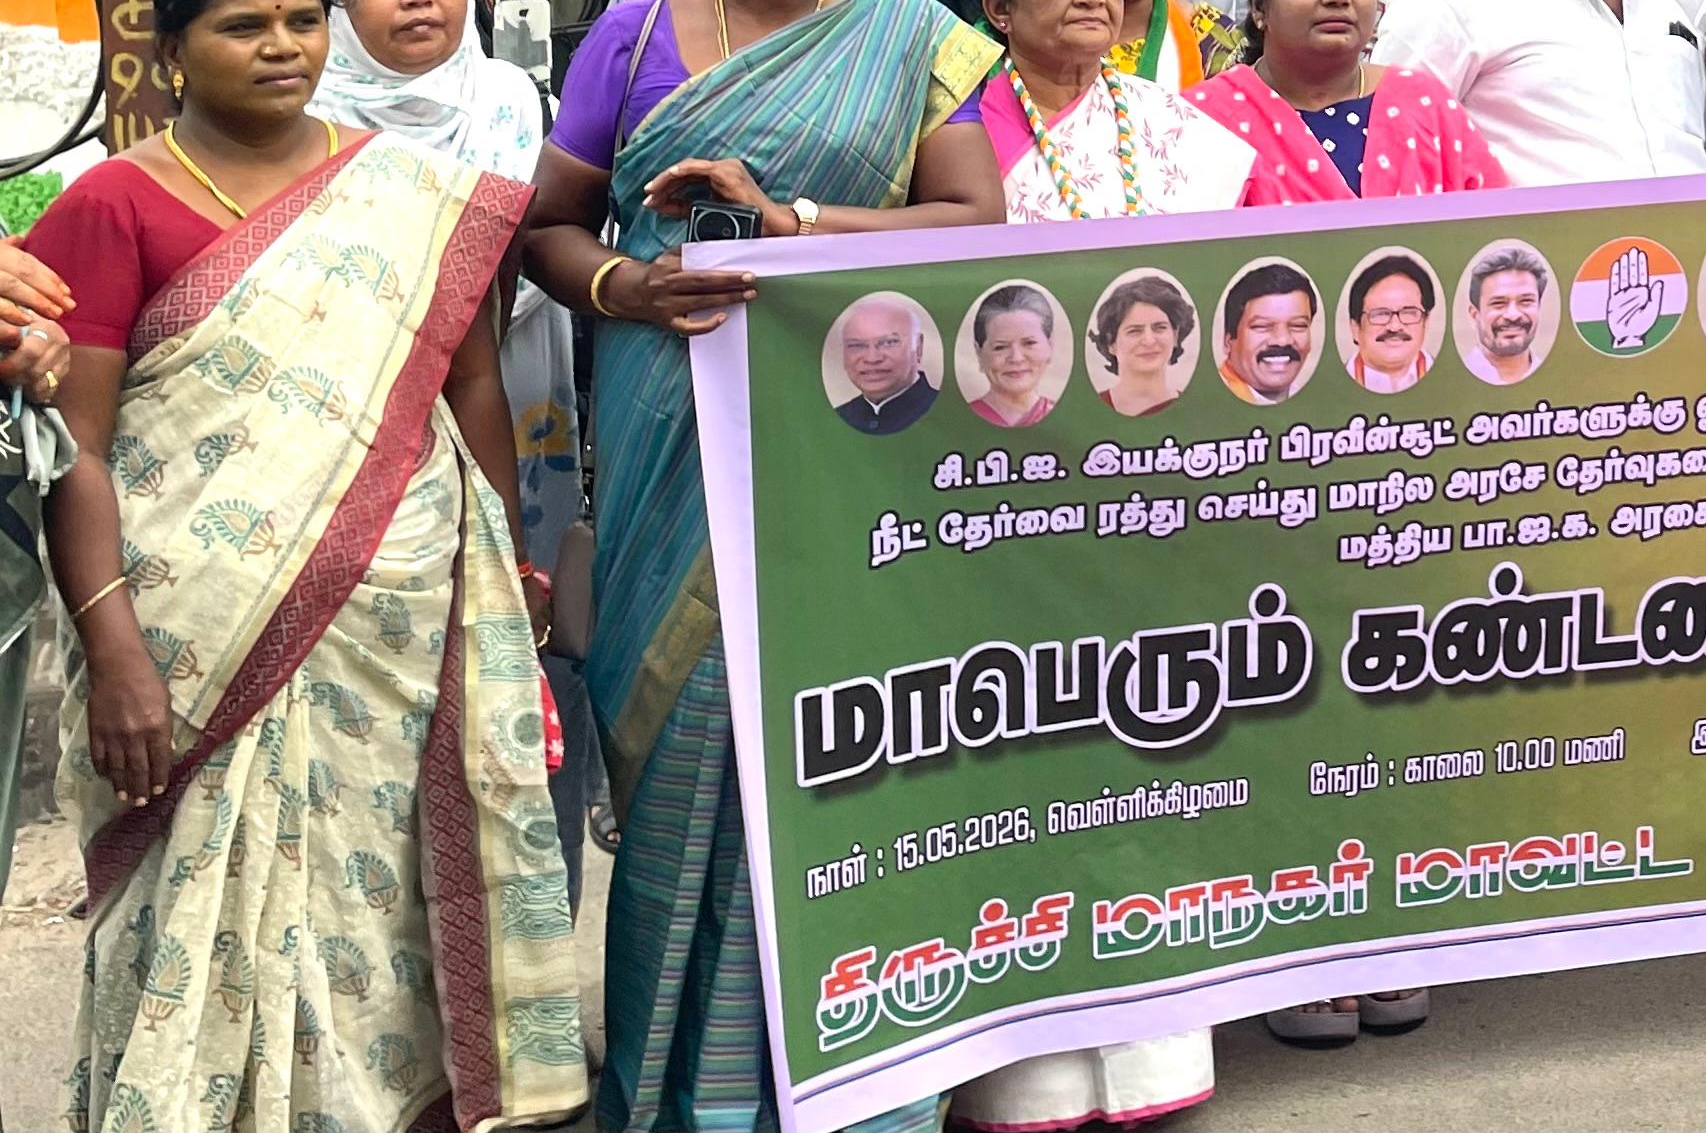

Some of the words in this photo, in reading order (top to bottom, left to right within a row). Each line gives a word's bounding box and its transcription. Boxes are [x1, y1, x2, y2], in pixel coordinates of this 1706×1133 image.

[933, 450, 1067, 489] சி.பி.ஐ.
[1082, 427, 1270, 479] இயக்குநர்
[1280, 415, 1457, 467] பிரவீன்சூட்
[1465, 393, 1687, 444] அவர்களுக்கு
[870, 512, 928, 568] நீட்
[937, 502, 1086, 552] தேர்வை
[1096, 492, 1186, 538] ரத்து
[1197, 479, 1317, 528] செய்து
[1328, 470, 1435, 515] மாநில
[1444, 461, 1547, 504] அரசே
[1339, 522, 1452, 568] மத்திய
[1463, 512, 1597, 549] பா.ஜ.க.
[795, 583, 1312, 786] மாபெரும்
[1309, 752, 1380, 798] நேரம்
[1403, 749, 1485, 784] காலை
[1493, 736, 1556, 774] 10.00
[1563, 727, 1625, 766] மணி
[806, 842, 869, 900] நாள்
[892, 806, 1037, 872] 15.05.2026,
[1046, 777, 1249, 835] வெள்ளிக்கிழமை
[815, 889, 1074, 1051] திருச்சி
[1092, 838, 1373, 959] மாநகர்
[1395, 824, 1694, 908] மாவட்ட
